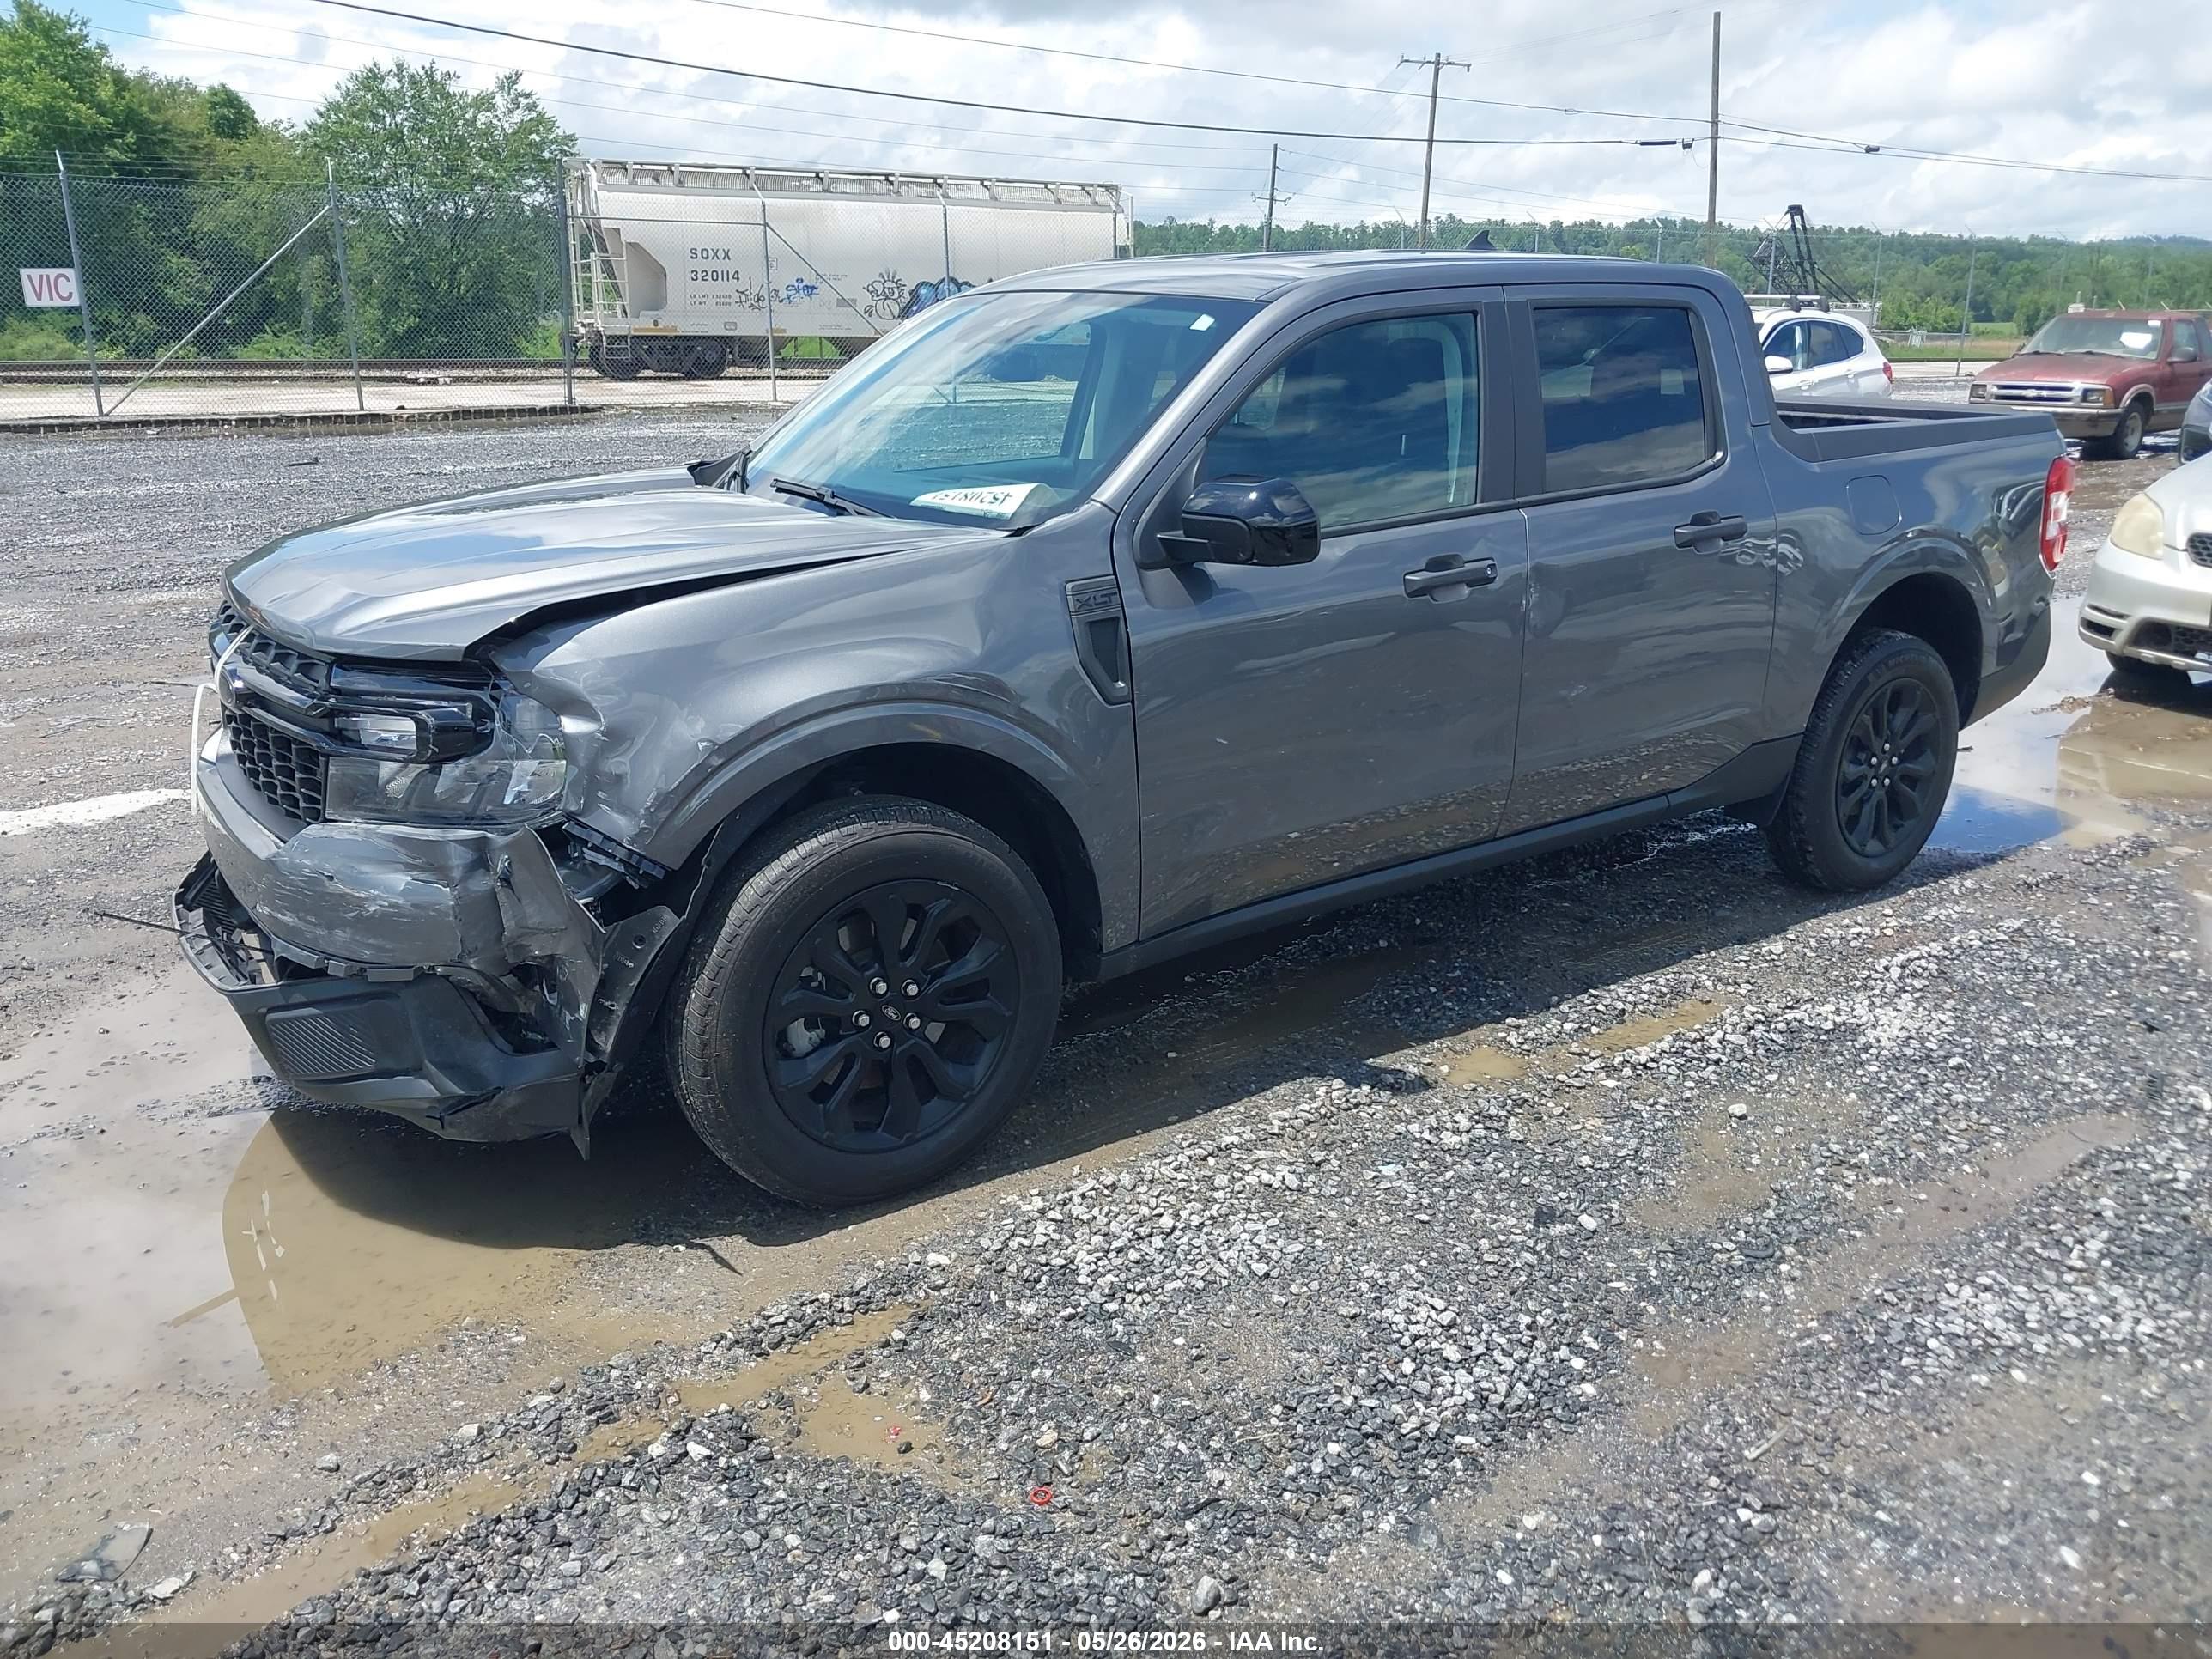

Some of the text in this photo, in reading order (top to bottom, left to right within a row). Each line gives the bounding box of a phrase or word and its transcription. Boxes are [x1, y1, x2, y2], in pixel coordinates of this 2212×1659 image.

[690, 248, 731, 260] SOXX
[690, 270, 740, 282] 320114
[27, 273, 73, 301] VIC
[1076, 592, 1118, 610] XLT
